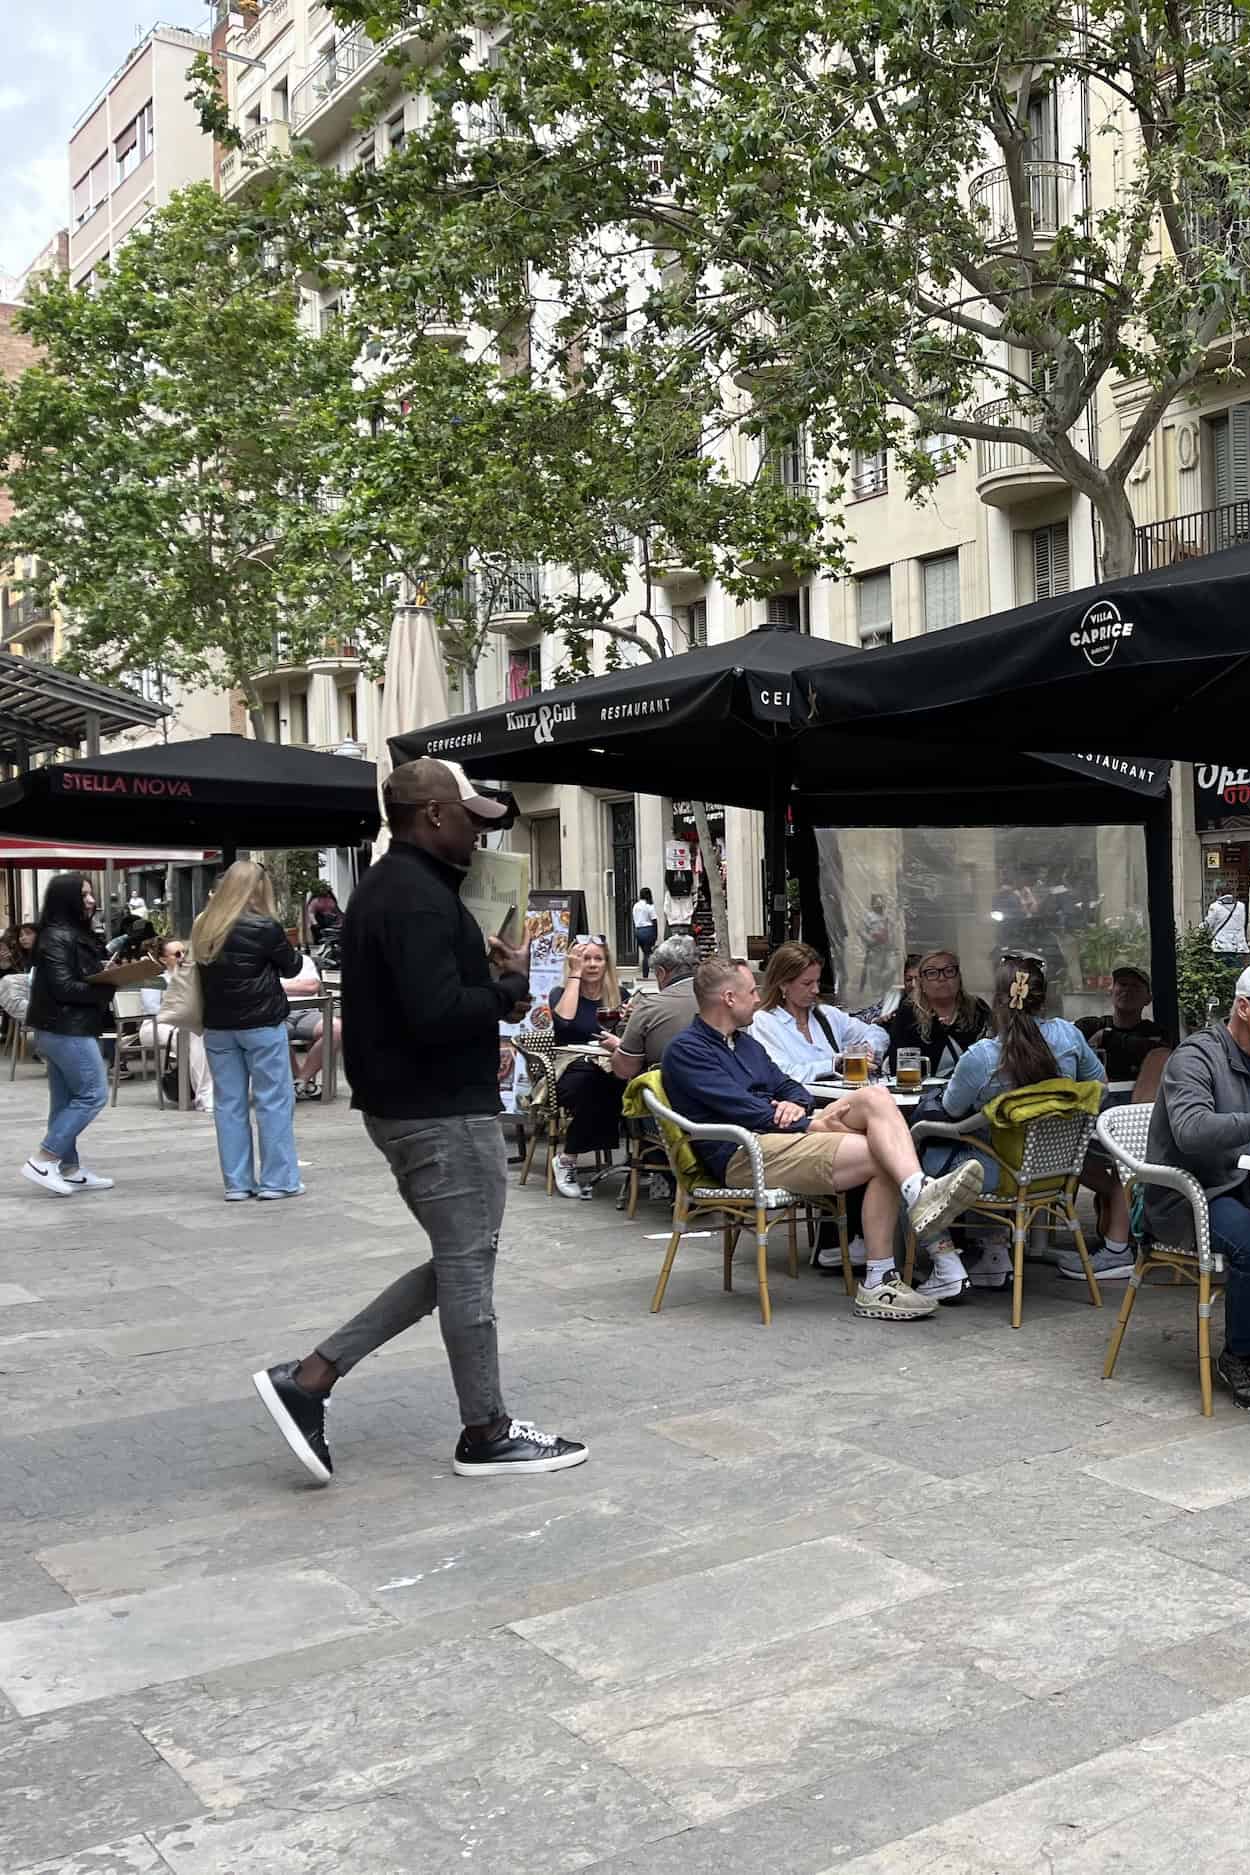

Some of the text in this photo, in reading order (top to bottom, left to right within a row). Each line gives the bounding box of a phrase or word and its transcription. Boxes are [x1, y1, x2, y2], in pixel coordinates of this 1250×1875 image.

[1090, 610, 1113, 624] VILLA
[1069, 622, 1134, 647] CAPRICE
[601, 697, 671, 721] RESTAURANT
[426, 731, 482, 753] CERVECERIA
[62, 772, 193, 797] STELLA NOVA
